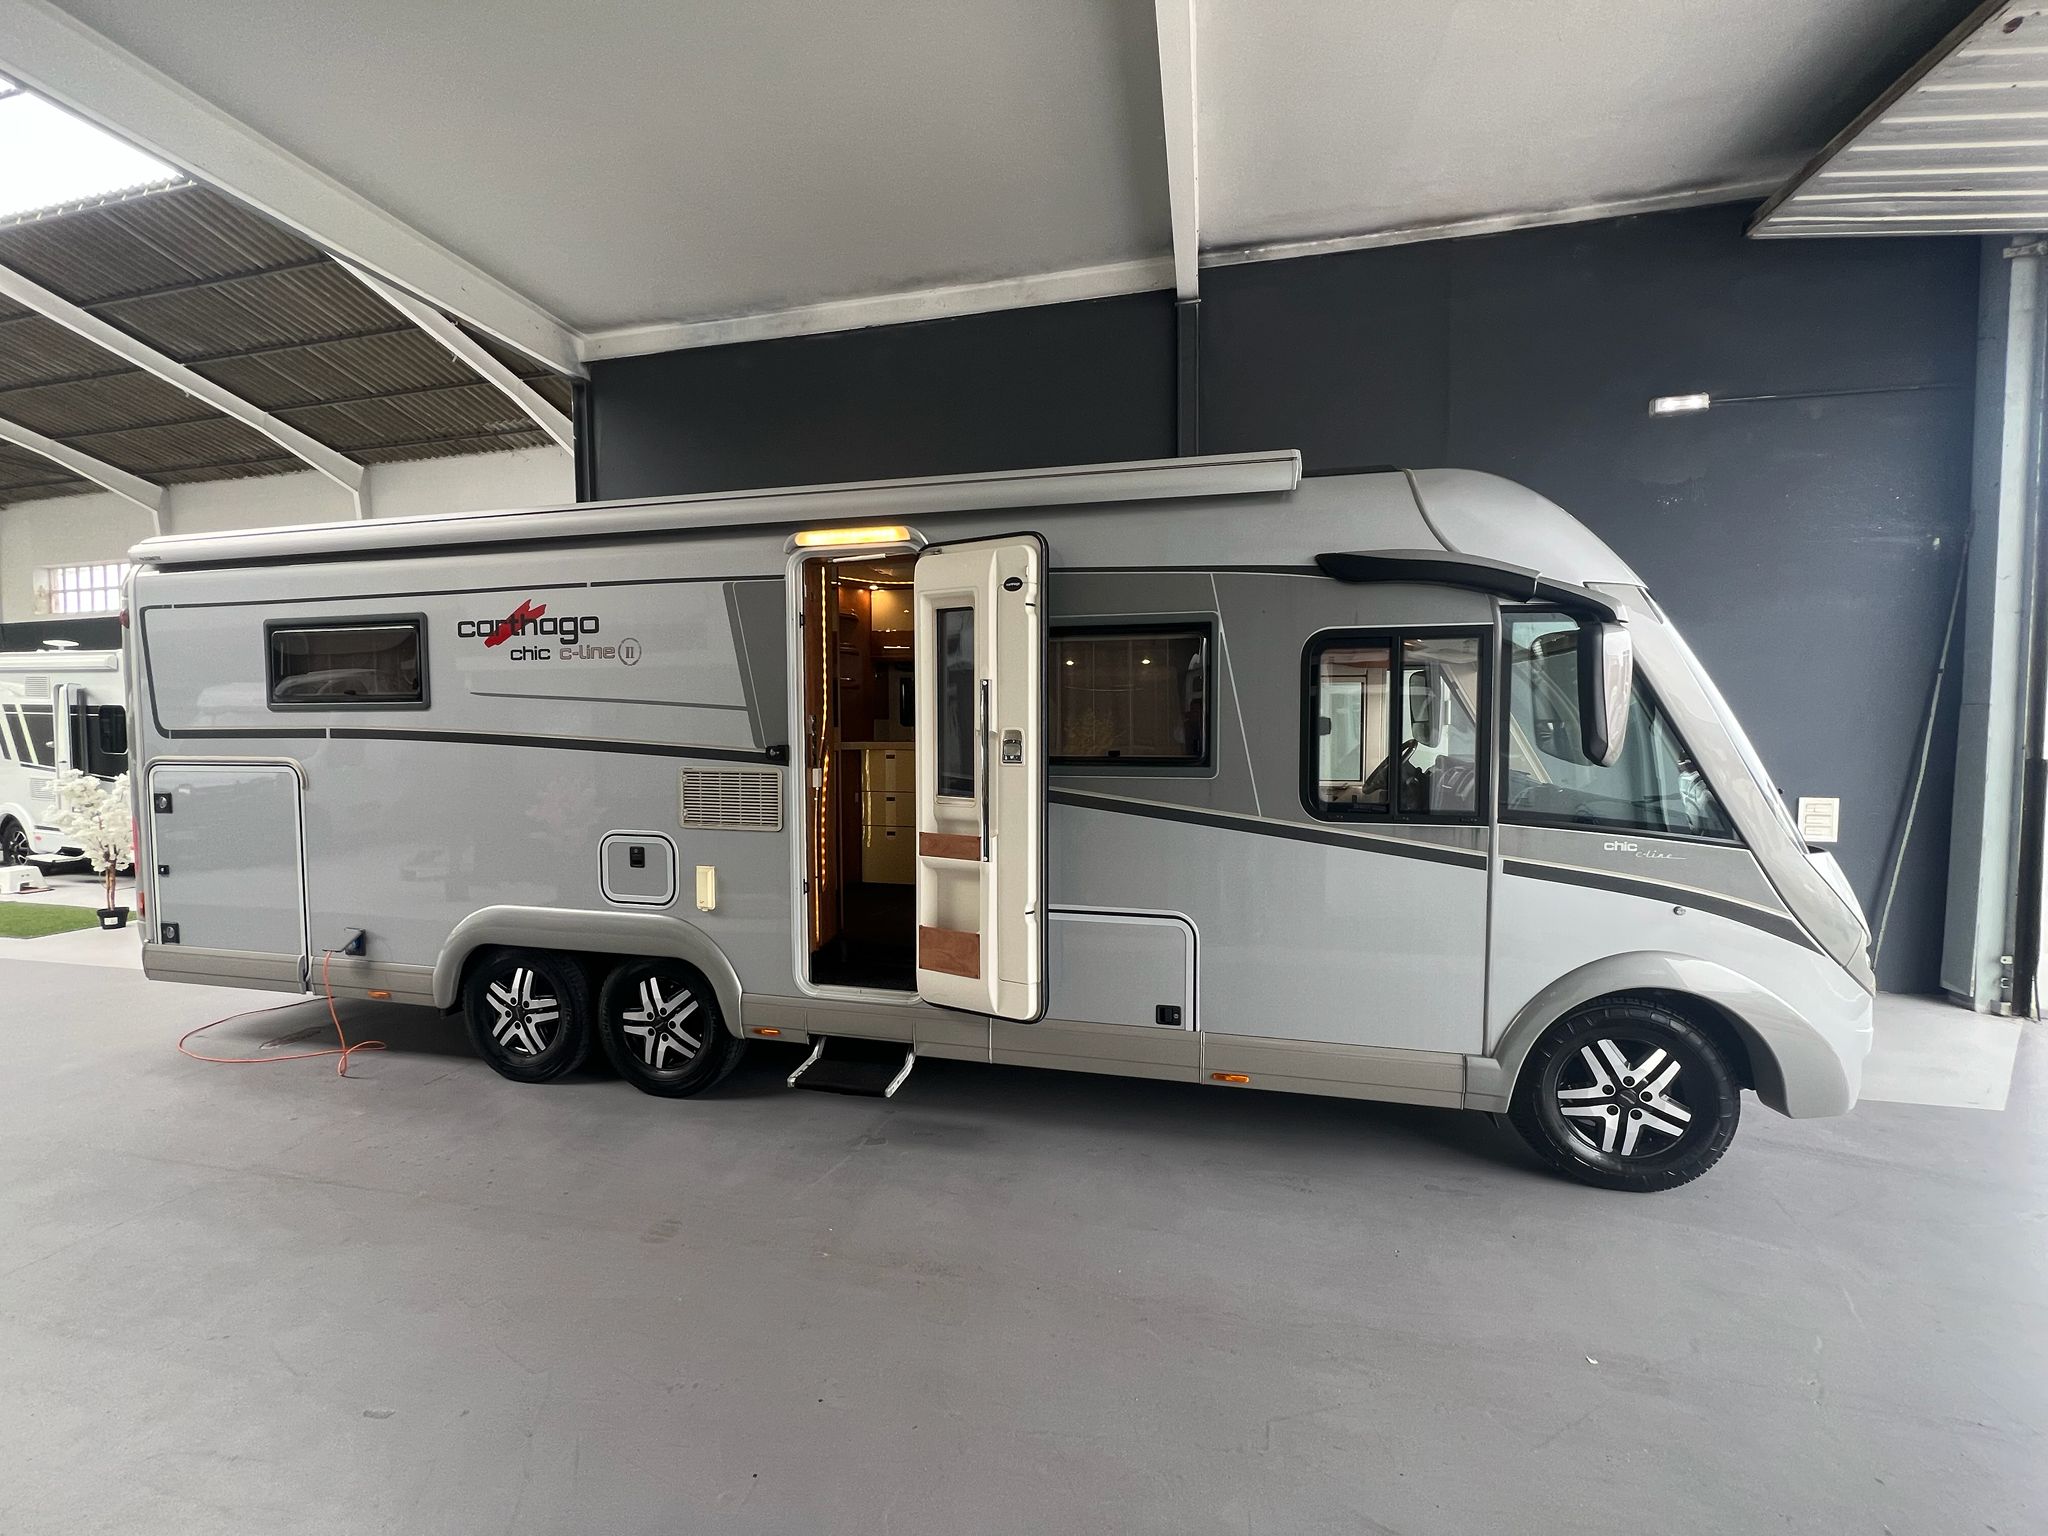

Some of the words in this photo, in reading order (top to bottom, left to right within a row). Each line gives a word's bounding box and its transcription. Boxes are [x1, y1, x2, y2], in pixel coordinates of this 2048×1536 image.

[457, 614, 600, 645] carthago
[510, 646, 551, 661] chic
[559, 645, 616, 660] c-line
[1603, 841, 1638, 852] chic
